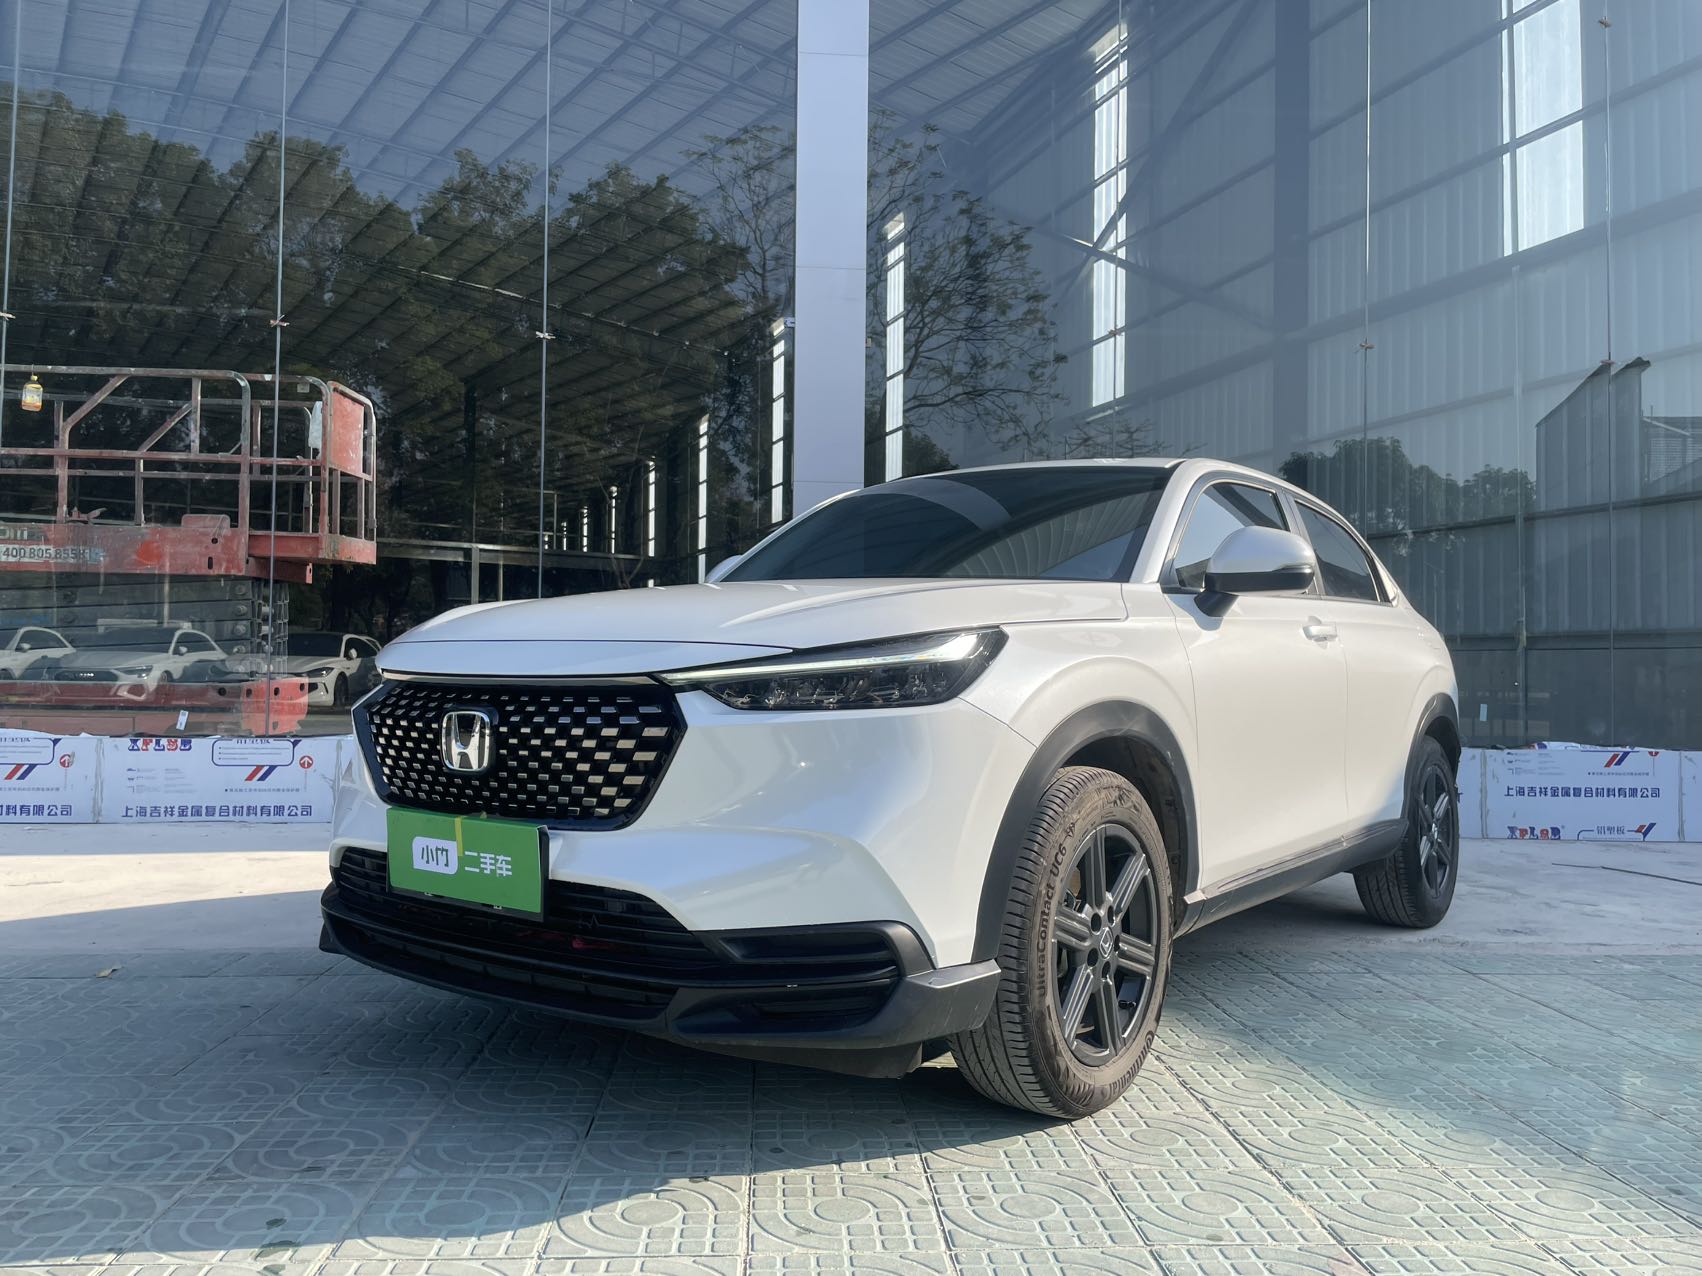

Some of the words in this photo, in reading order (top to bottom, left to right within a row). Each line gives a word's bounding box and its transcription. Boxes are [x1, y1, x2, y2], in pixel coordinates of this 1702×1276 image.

[1504, 785, 1661, 799] 上海吉祥金属复合材料有限公司
[121, 804, 313, 818] 上海吉祥金属复合材料有限公司
[464, 851, 513, 877] 二手车
[1050, 843, 1067, 878] UC6
